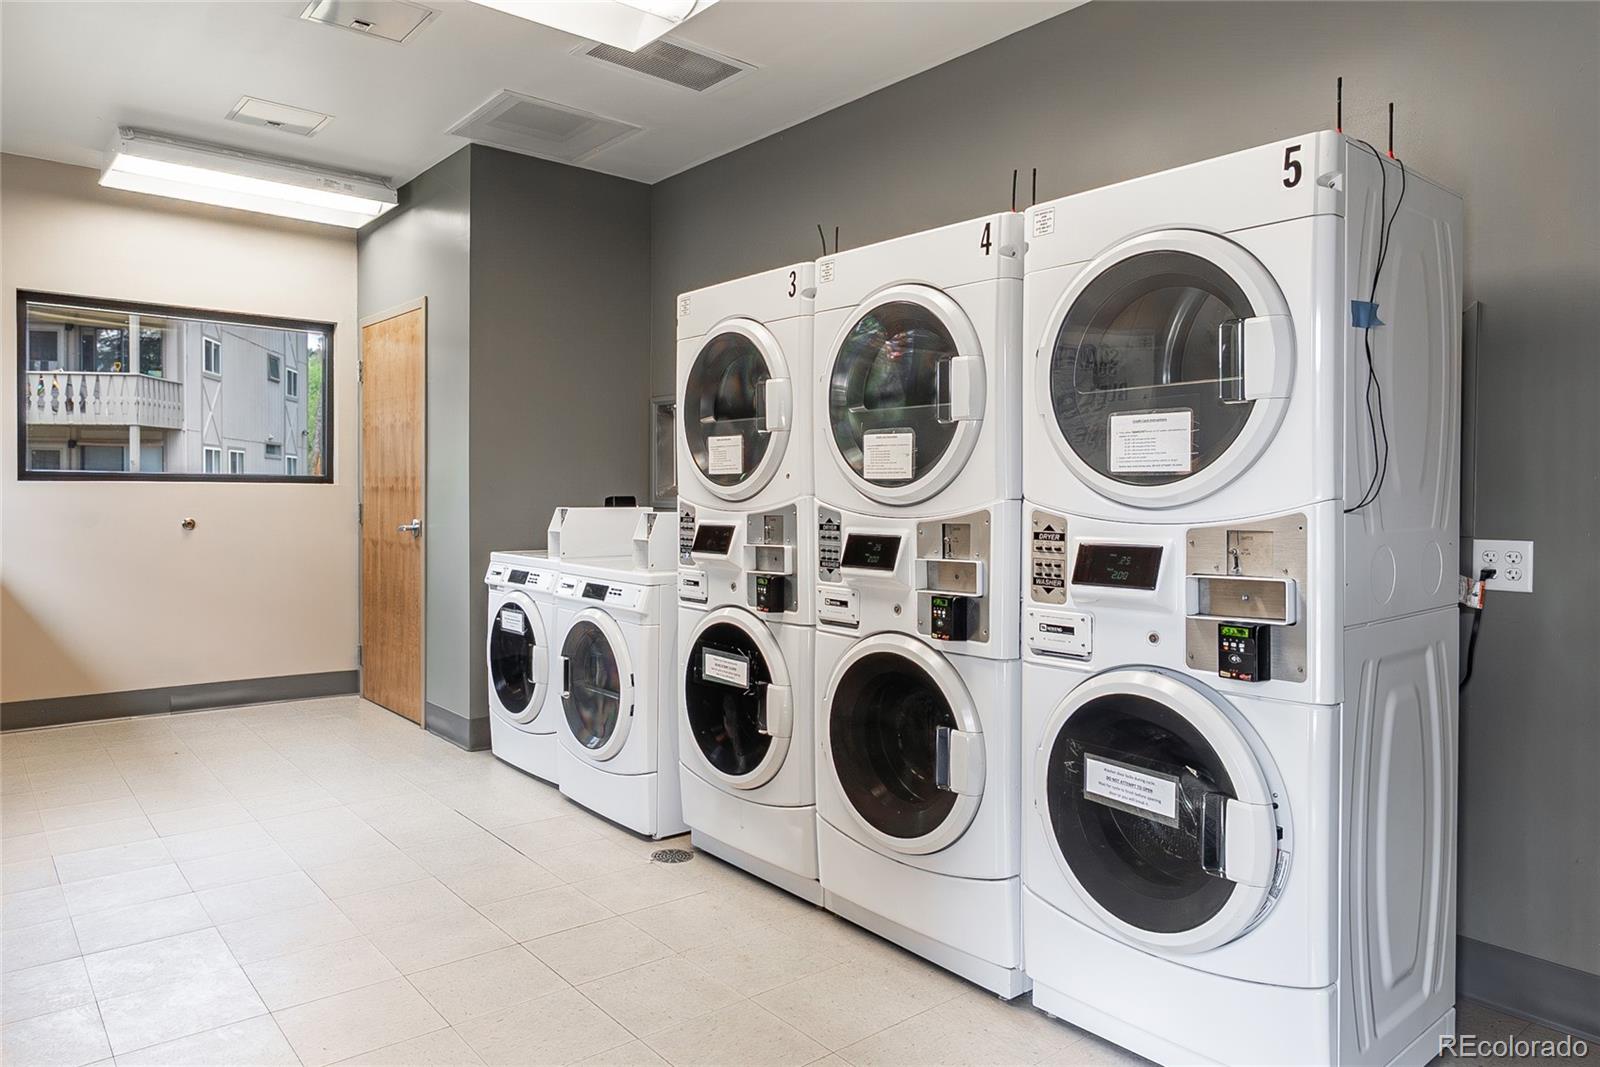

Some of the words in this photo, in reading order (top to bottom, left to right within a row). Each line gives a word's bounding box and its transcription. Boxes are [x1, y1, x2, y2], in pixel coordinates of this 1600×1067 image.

[1282, 144, 1302, 188] 5
[980, 222, 992, 255] 4
[788, 271, 797, 298] 3
[1038, 533, 1061, 541] DRYER
[1035, 578, 1062, 587] WASHER
[1120, 779, 1135, 788] ATTEMPT
[1142, 786, 1153, 794] OPEN
